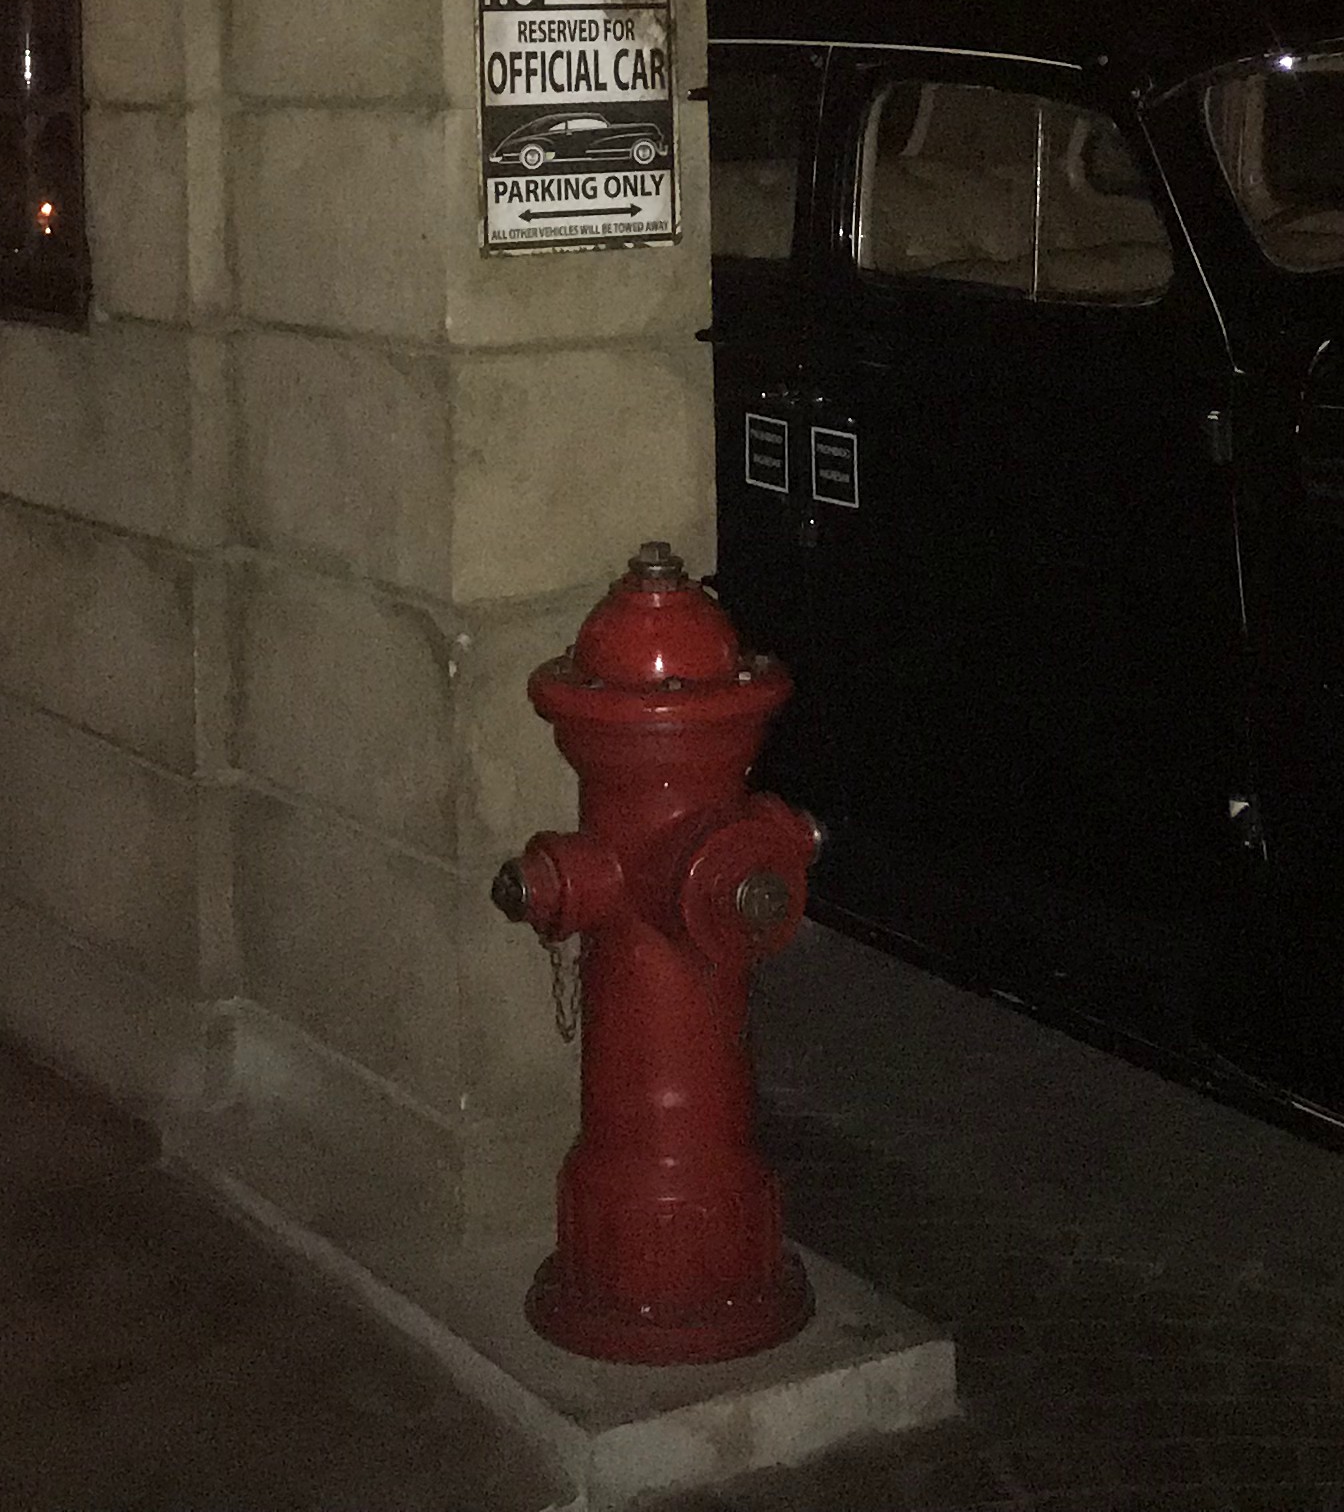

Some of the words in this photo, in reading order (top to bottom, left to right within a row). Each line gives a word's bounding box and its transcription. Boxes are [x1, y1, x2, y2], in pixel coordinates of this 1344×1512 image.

[518, 19, 599, 43] RESERVED
[603, 18, 635, 41] FOR
[487, 50, 607, 94] OFFICIAL
[613, 48, 666, 91] CAR
[494, 176, 597, 204] PARKING
[604, 173, 665, 199] ONLY
[491, 229, 508, 241] ALL
[509, 227, 538, 239] OTHER
[539, 224, 579, 237] VEHICLES
[580, 224, 600, 235] WILL
[602, 223, 612, 234] BE
[613, 222, 644, 233] TOWED
[645, 220, 668, 232] AWAY
